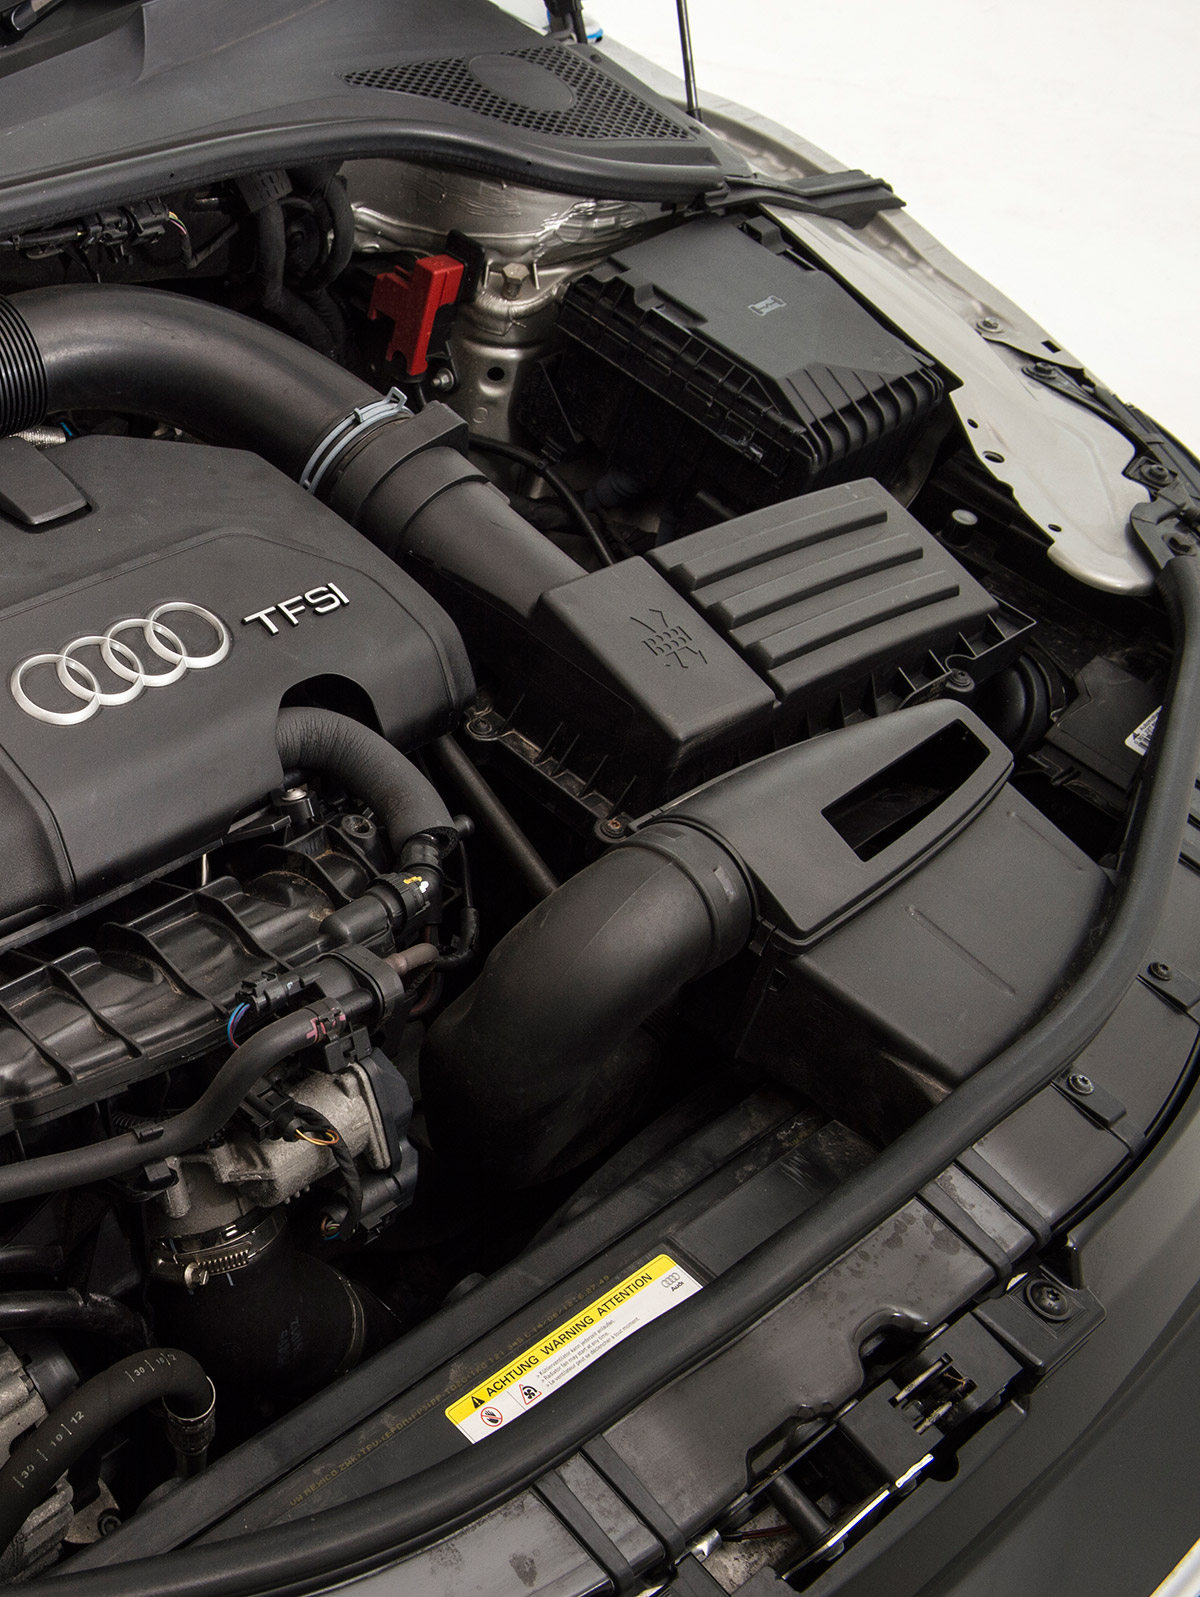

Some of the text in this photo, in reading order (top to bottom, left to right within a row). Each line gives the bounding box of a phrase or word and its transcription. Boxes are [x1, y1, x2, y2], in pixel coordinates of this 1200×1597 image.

[241, 582, 349, 636] TFSI
[671, 1281, 684, 1292] Audi
[486, 1273, 652, 1397] ACHTUNG WARNING ATTENTION
[134, 1366, 145, 1377] 30
[155, 1356, 165, 1365] 10
[21, 1410, 85, 1479] 30 10 12
[303, 1468, 339, 1495] MEXICO
